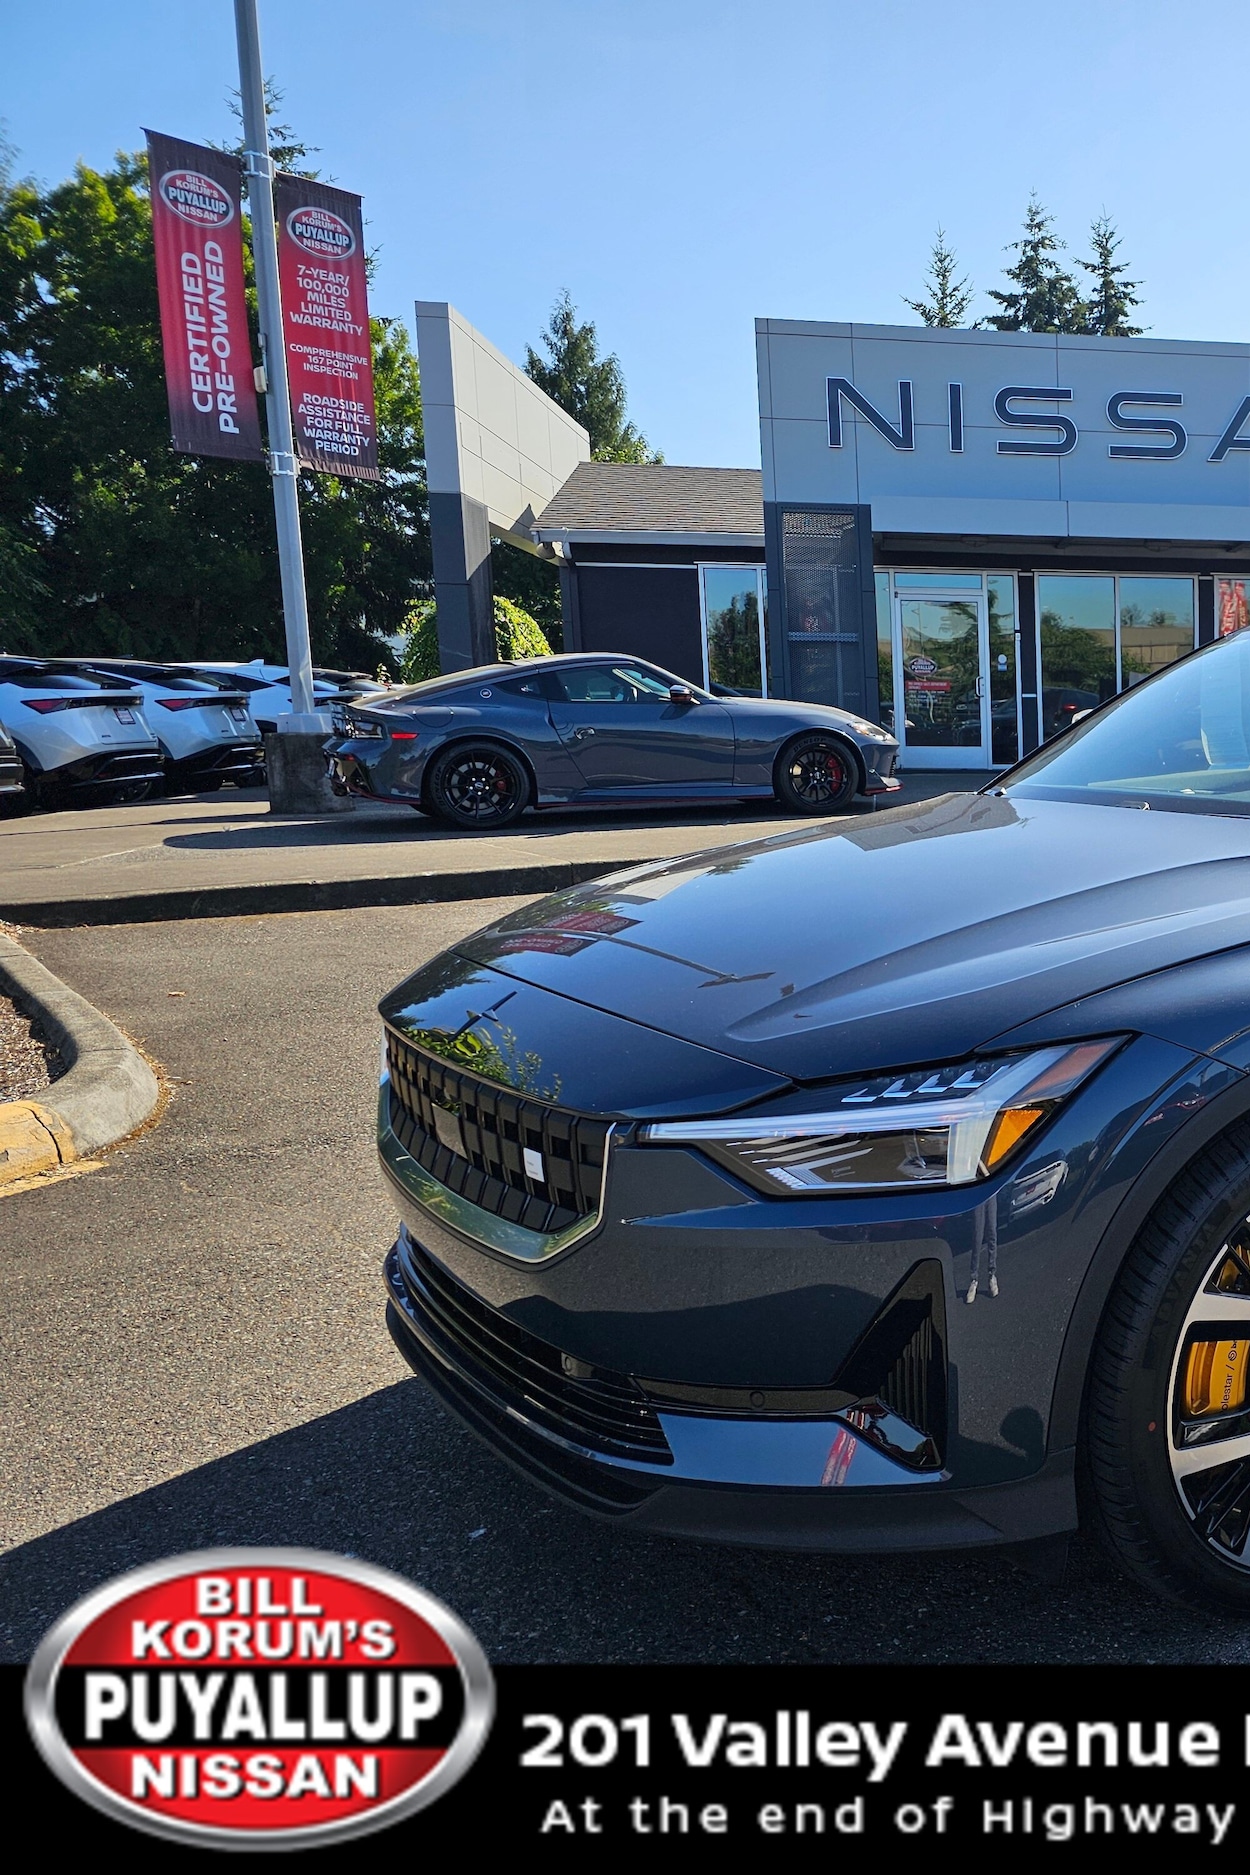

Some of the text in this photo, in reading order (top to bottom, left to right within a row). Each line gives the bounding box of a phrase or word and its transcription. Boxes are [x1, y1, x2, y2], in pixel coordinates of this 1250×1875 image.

[176, 179, 219, 198] KORUM'S
[186, 175, 208, 187] BILL
[168, 186, 227, 214] PUYALLUP
[178, 203, 218, 222] NISSAN
[311, 211, 331, 222] BILL
[302, 216, 342, 232] KORUM'S
[295, 223, 349, 247] PUYALLUP
[303, 238, 341, 254] NISSAN
[297, 264, 350, 287] 7-YEAR/
[297, 277, 350, 298] 100,000
[307, 291, 346, 309] MILES
[300, 301, 352, 321] LIMITED
[181, 252, 213, 413] CERTIFIED
[289, 311, 363, 336] WARRANTY
[204, 240, 240, 434] PRE-OWNED
[289, 343, 369, 366] COMPREHENSIVE
[307, 355, 354, 371] 167 POINT
[303, 362, 359, 380] INSPECTION
[303, 392, 365, 413] ROADSIDE
[298, 403, 371, 425] ASSISTANCE
[306, 416, 363, 435] FOR FULL
[303, 426, 370, 447] WARRANTY
[315, 439, 359, 456] PERIOD
[1221, 1374, 1233, 1411] olestar
